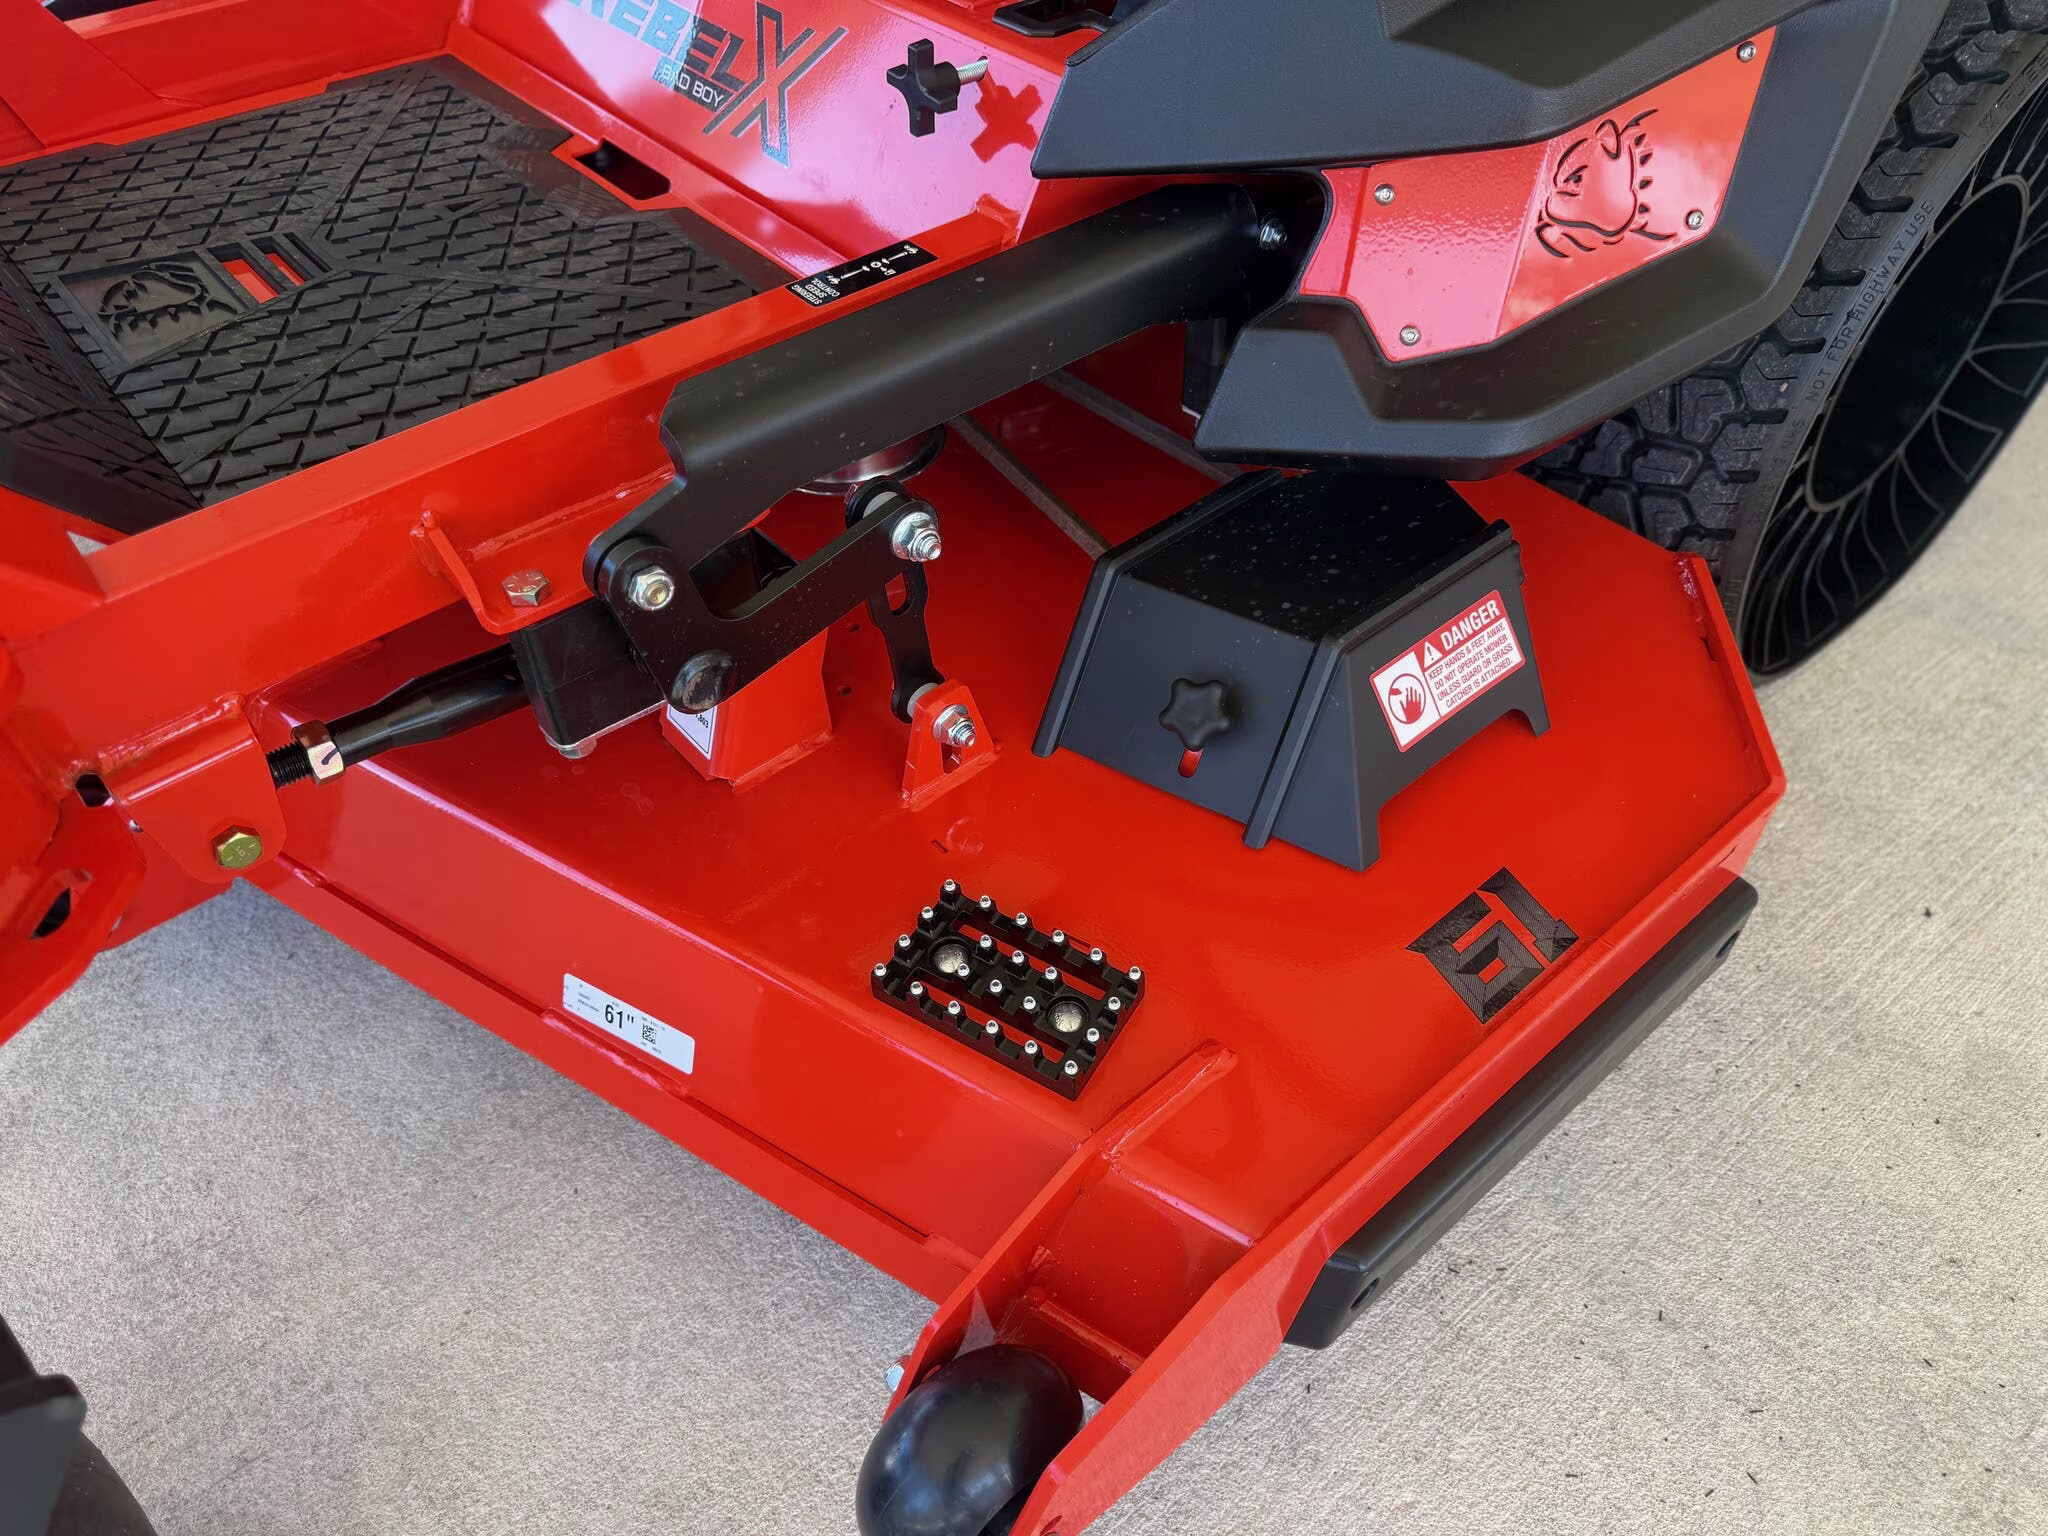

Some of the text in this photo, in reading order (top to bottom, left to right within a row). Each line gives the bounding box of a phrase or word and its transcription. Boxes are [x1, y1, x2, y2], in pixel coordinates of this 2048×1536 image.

[566, 0, 748, 93] EBEL
[661, 62, 725, 108] BAD BOY
[805, 284, 828, 298] SPEED
[811, 277, 840, 297] CONTROL
[1805, 200, 1935, 401] NOT FOR HIGHWAY USE
[1428, 622, 1506, 680] KEEP HANDS & FEET AWAY.
[1440, 599, 1500, 651] DANGER
[1434, 634, 1508, 690] DO NOT OPERATE MOWER
[1437, 643, 1513, 701] UNLESS GUARD OR GRASS
[1445, 657, 1513, 708] CATCHER IS ATTACHED.
[1405, 866, 1580, 1024] 61
[604, 1003, 635, 1029] 61"
